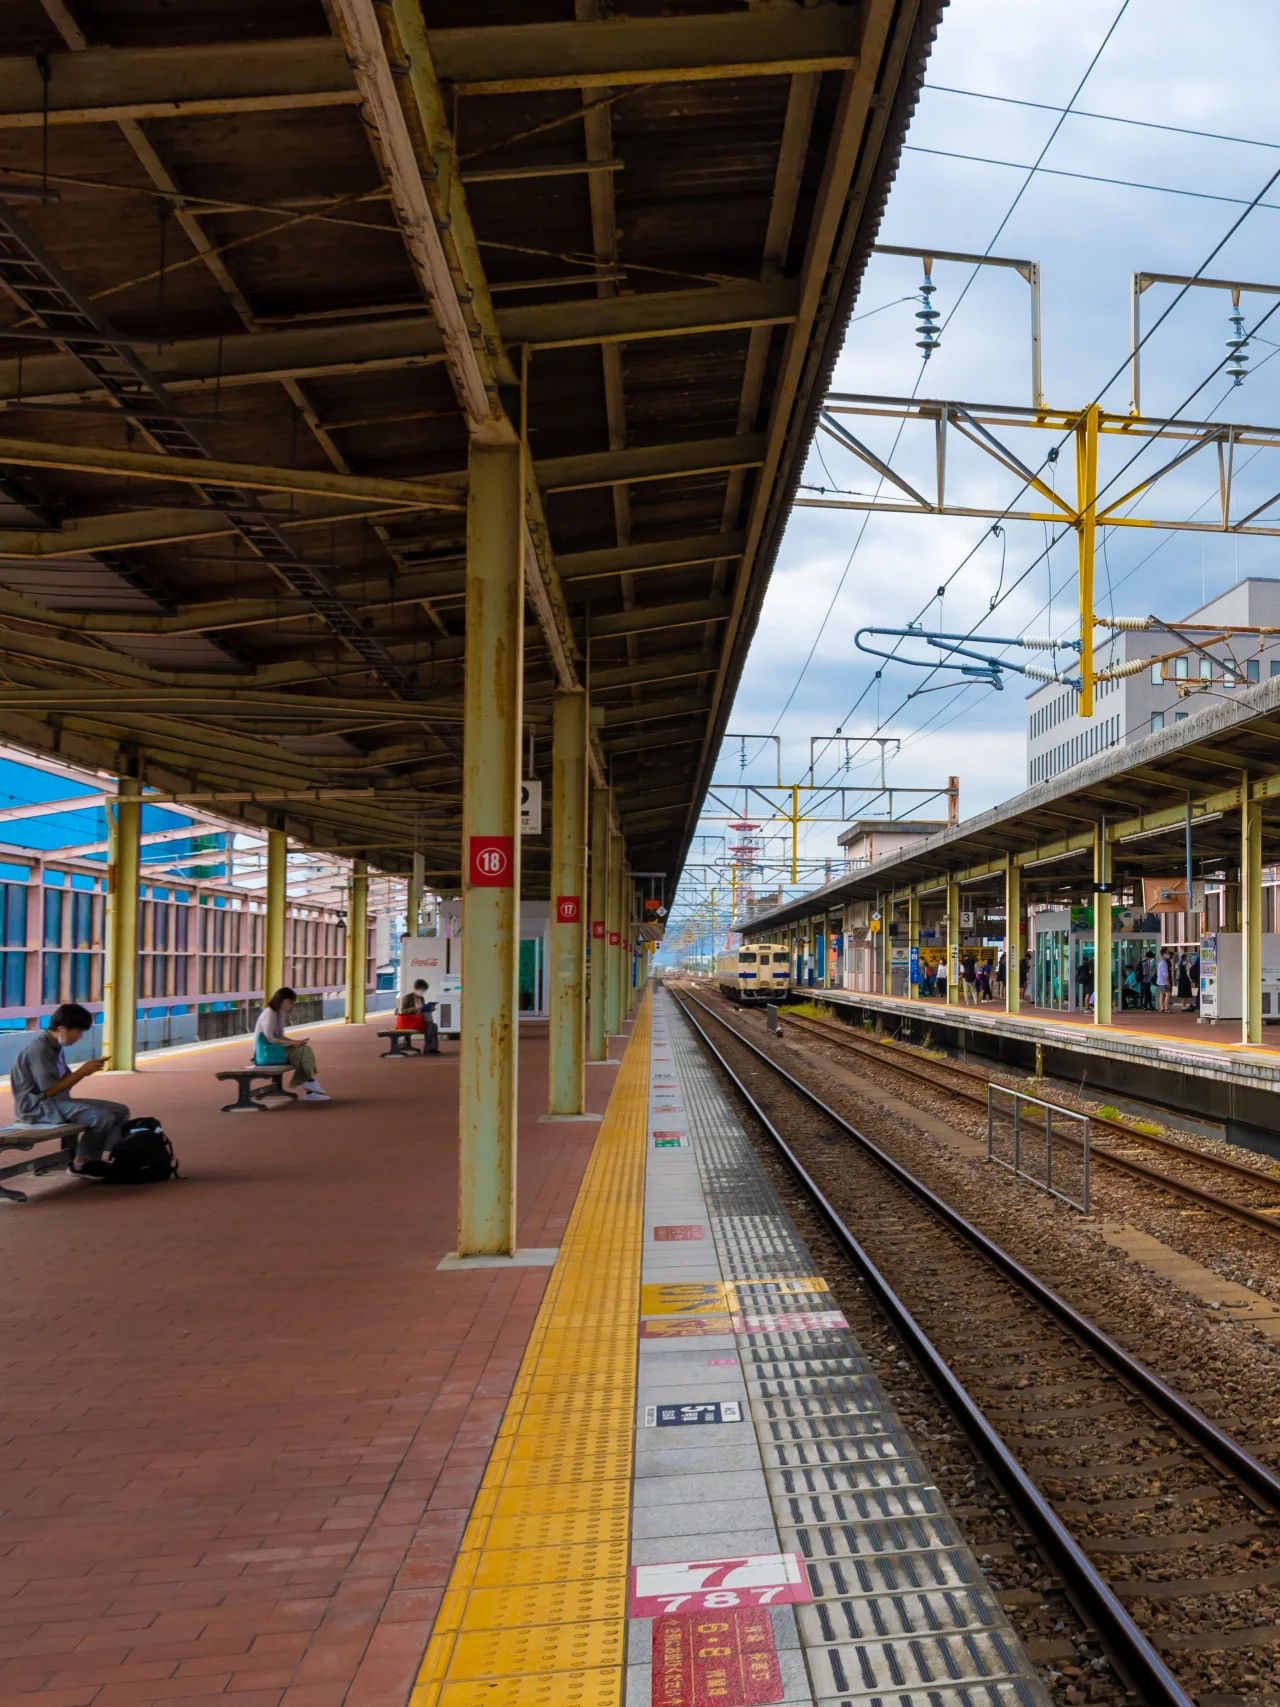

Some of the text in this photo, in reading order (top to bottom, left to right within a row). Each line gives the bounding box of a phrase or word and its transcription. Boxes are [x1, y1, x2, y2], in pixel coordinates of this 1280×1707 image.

[482, 852, 500, 871] 18
[563, 904, 573, 915] 17
[963, 913, 970, 923] 3
[411, 957, 439, 967] Coca-Cola
[688, 1560, 748, 1588] 7
[657, 1587, 784, 1613] 787
